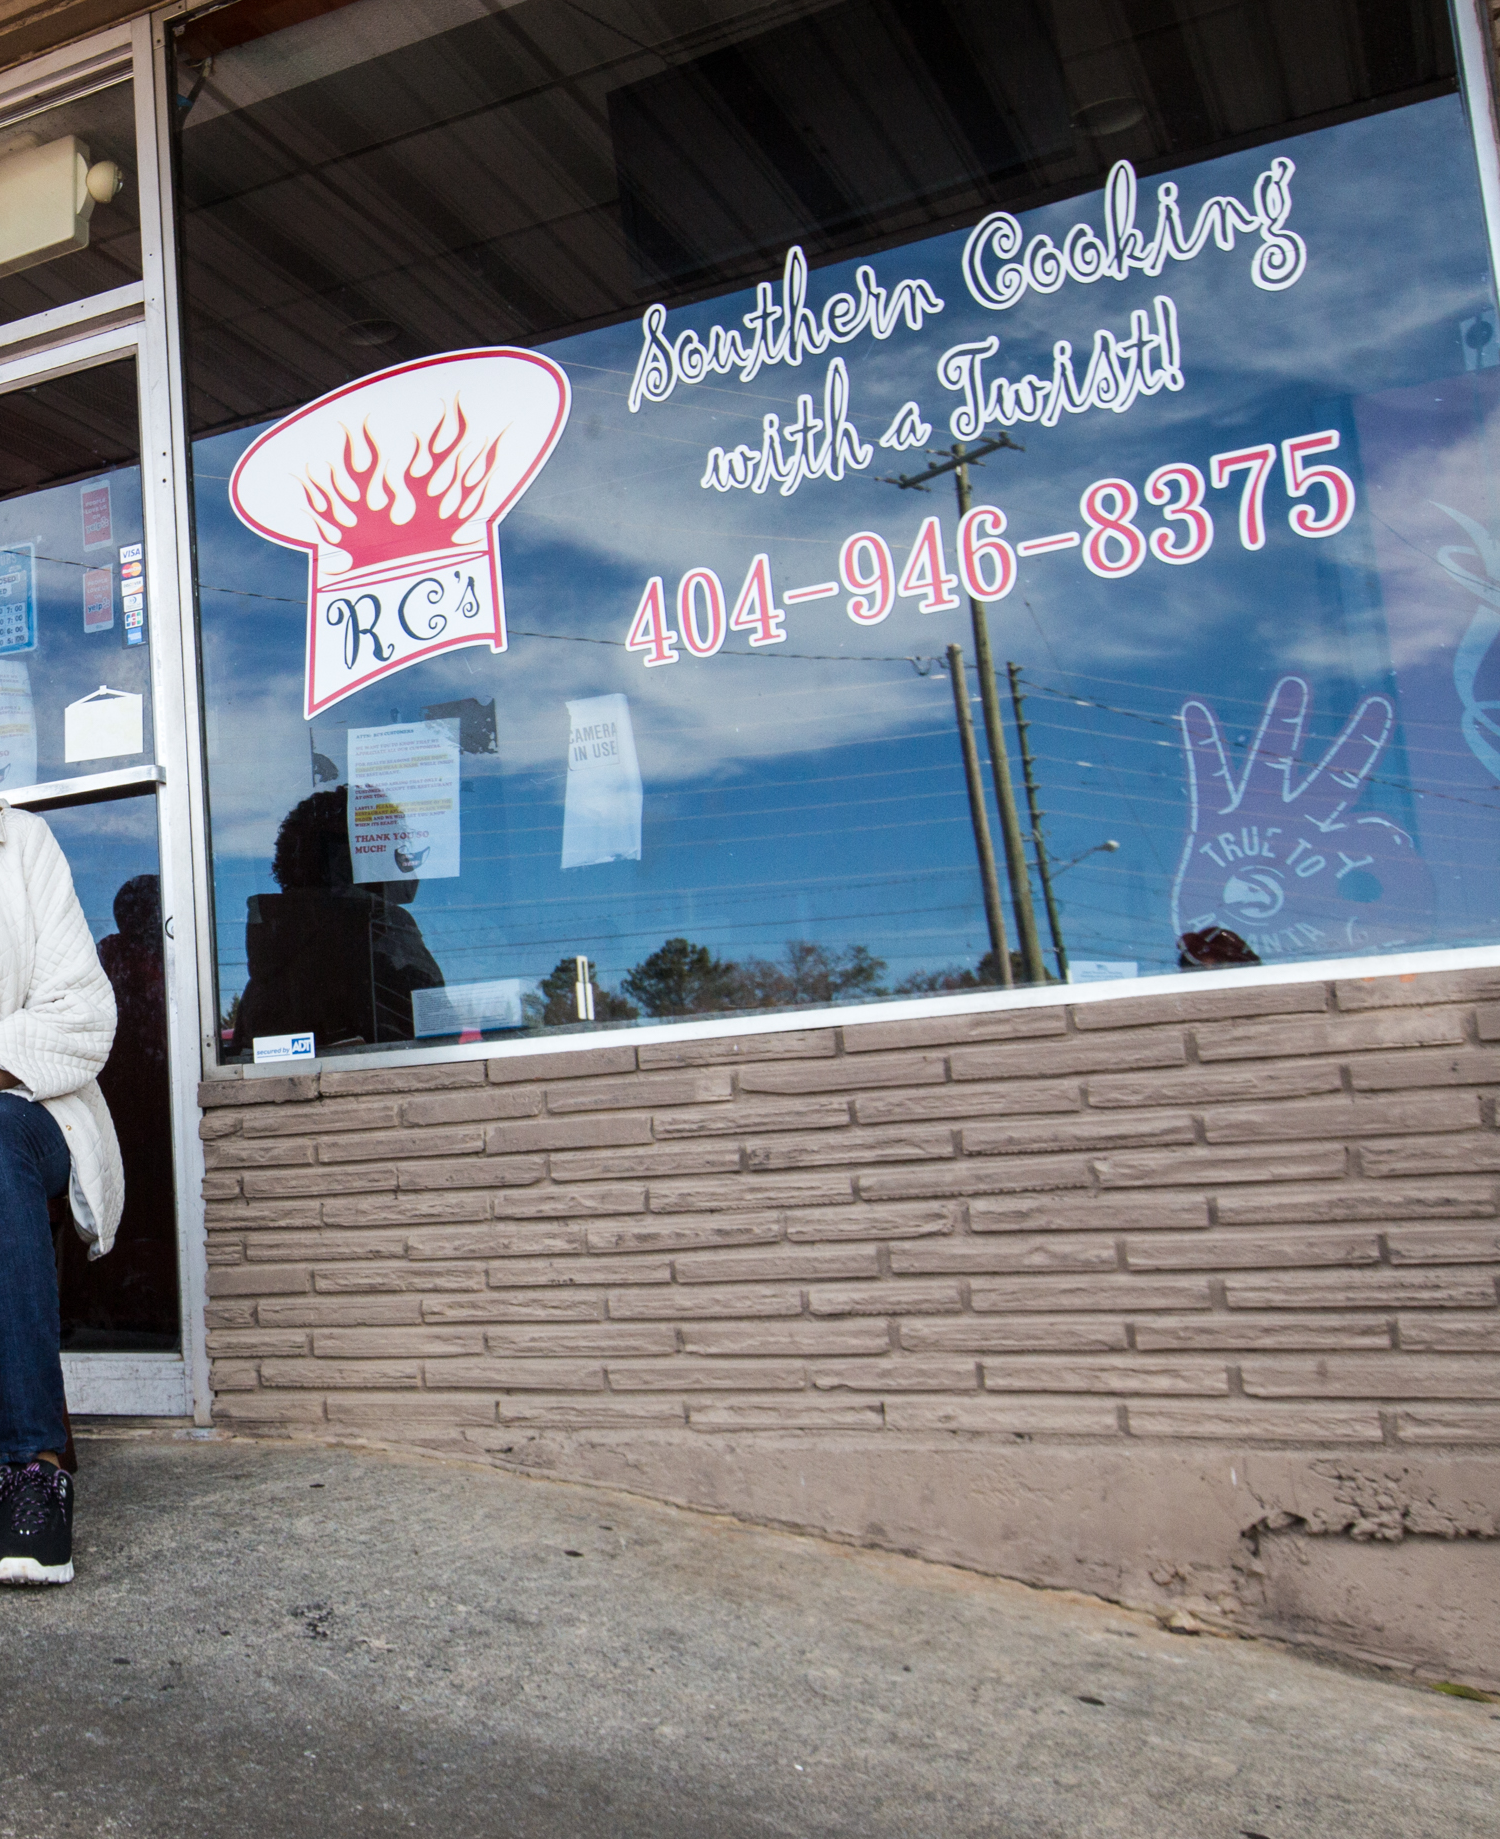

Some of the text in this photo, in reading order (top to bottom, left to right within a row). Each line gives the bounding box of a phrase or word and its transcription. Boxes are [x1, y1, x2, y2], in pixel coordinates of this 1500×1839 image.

[628, 157, 1305, 412] Southern Cooking
[701, 296, 1184, 496] with a Twist!
[122, 548, 141, 559] VISA
[625, 430, 1355, 667] 404-946-8375
[574, 741, 617, 761] IN USE
[355, 830, 429, 843] THANK YOU SO
[355, 844, 387, 854] MUCH!
[1199, 826, 1282, 868] TRUE
[1286, 838, 1326, 877] TO
[1187, 912, 1326, 955] ATANTA
[257, 1047, 282, 1056] secured
[292, 1040, 311, 1052] ADT
